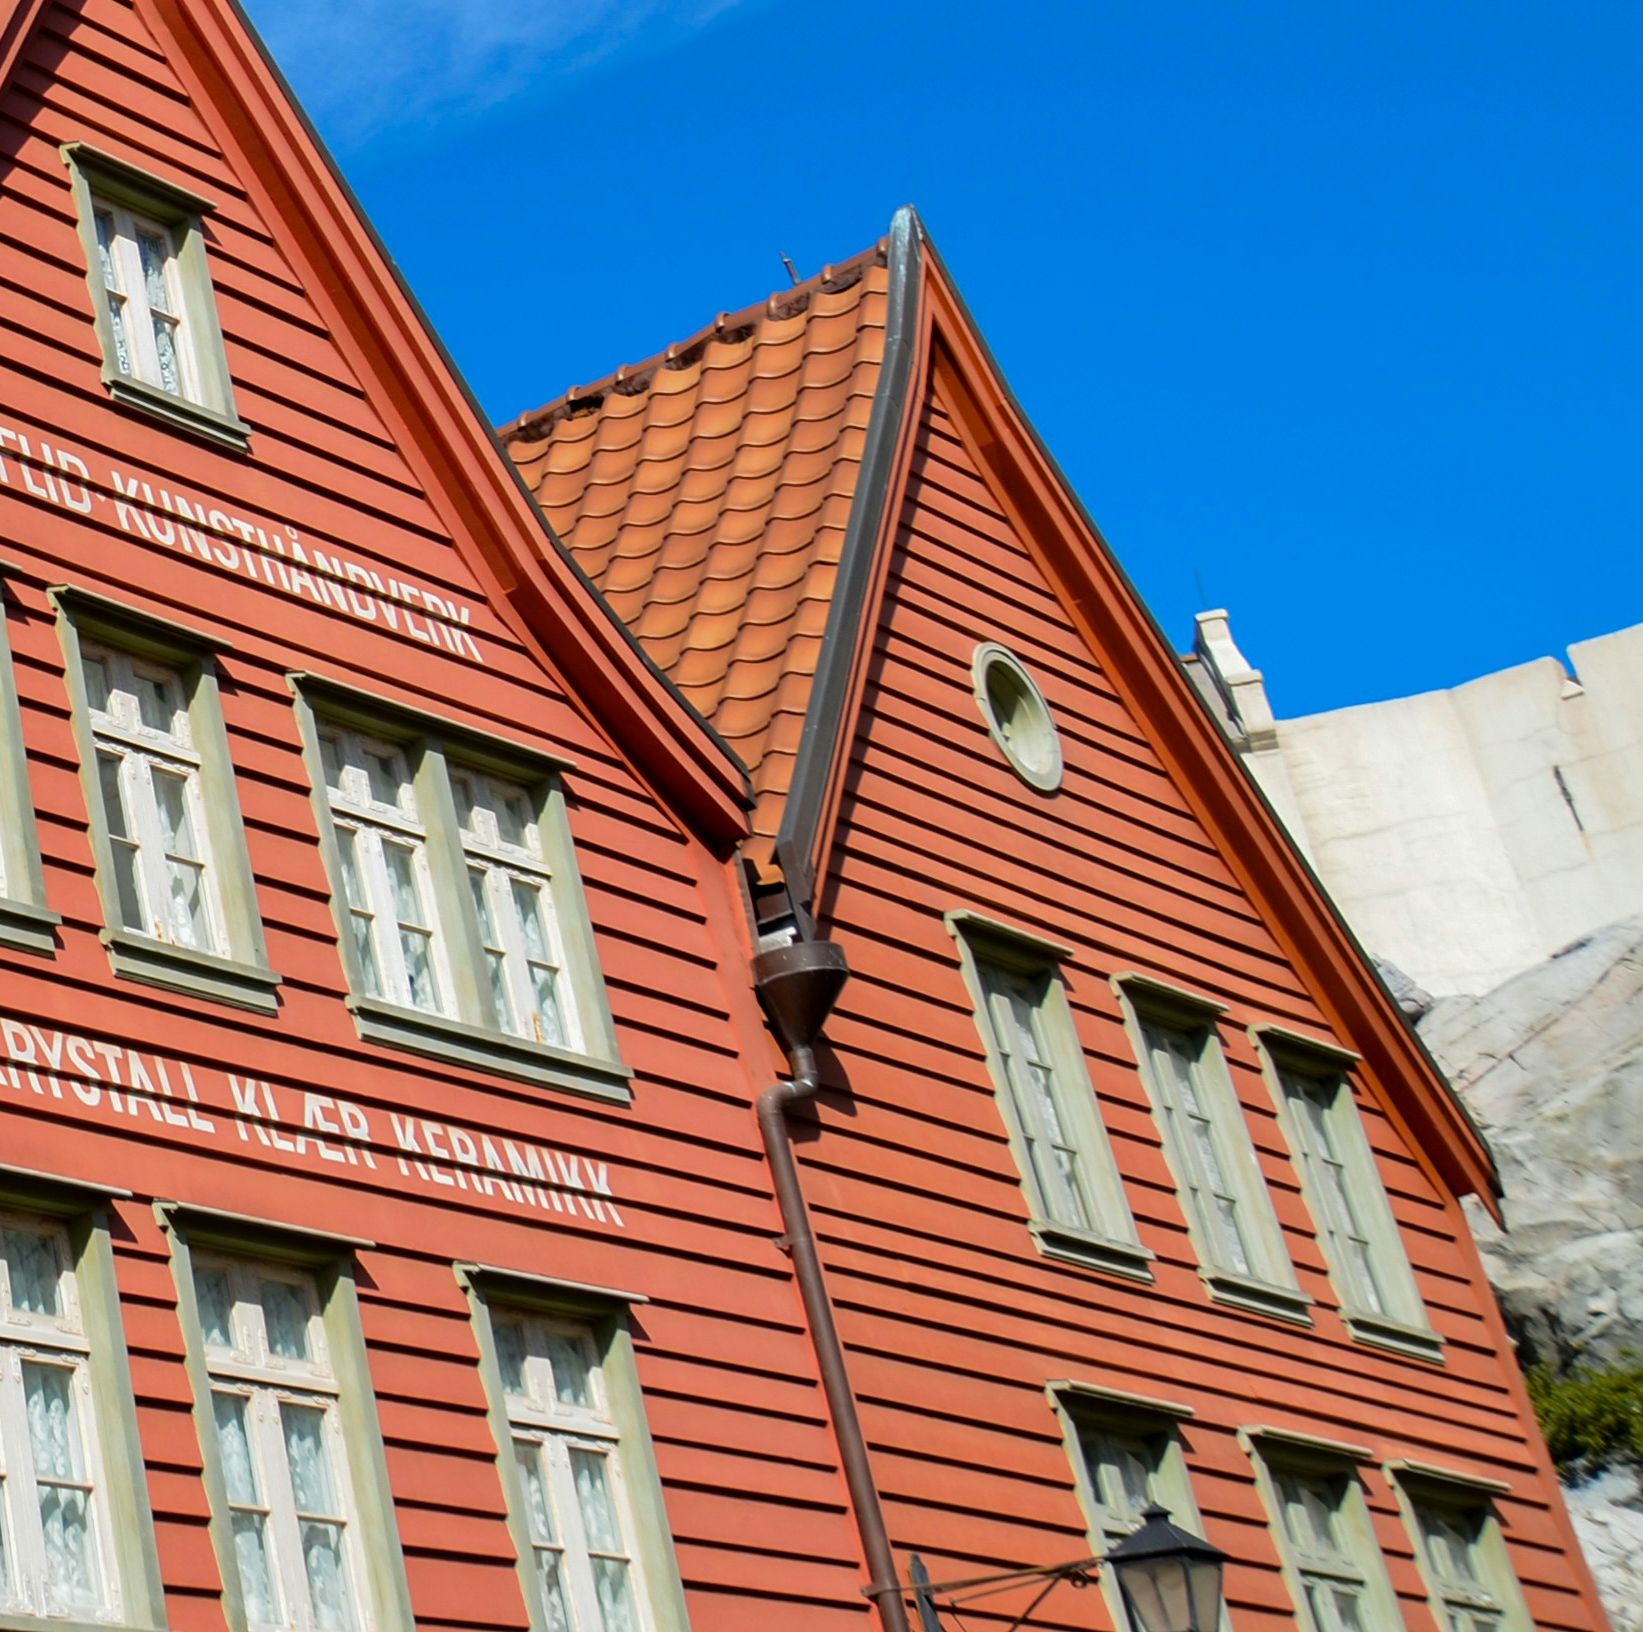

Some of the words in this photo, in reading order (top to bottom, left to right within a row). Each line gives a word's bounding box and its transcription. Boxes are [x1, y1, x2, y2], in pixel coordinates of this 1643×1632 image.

[111, 470, 483, 662] KUNSTHÅNDVERK
[227, 1073, 377, 1169] KLÆR
[390, 1112, 625, 1228] KERAMIKK
